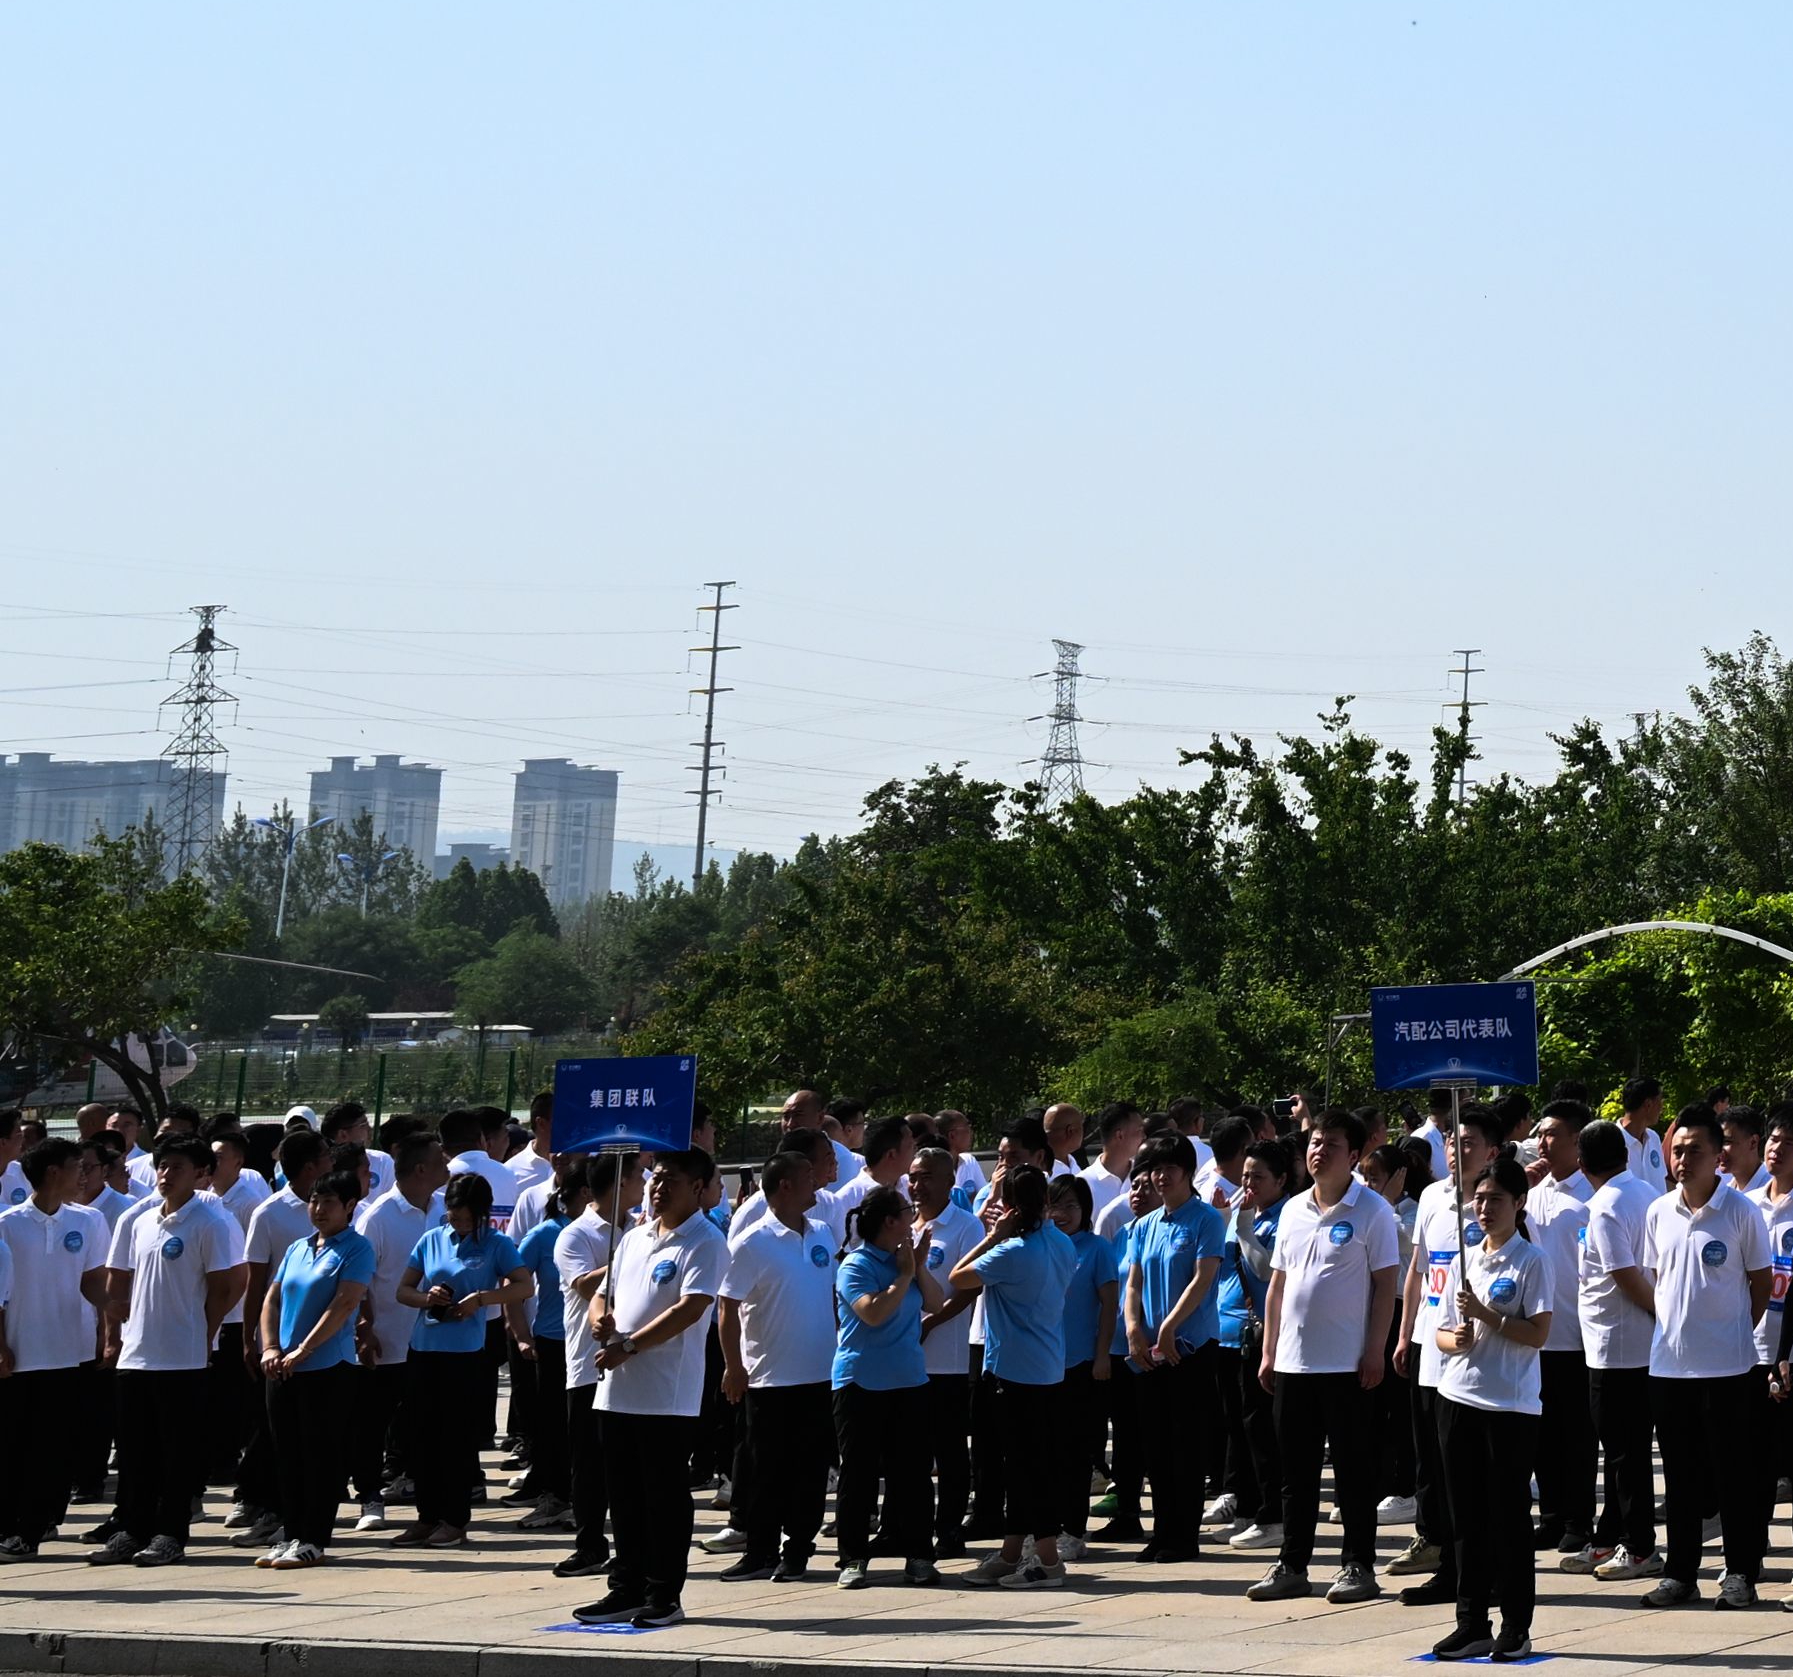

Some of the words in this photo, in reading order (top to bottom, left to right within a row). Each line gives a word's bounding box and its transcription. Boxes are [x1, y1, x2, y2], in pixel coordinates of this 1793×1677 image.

[1394, 1017, 1513, 1042] 汽配公司代表队
[589, 1087, 657, 1108] 集团联队
